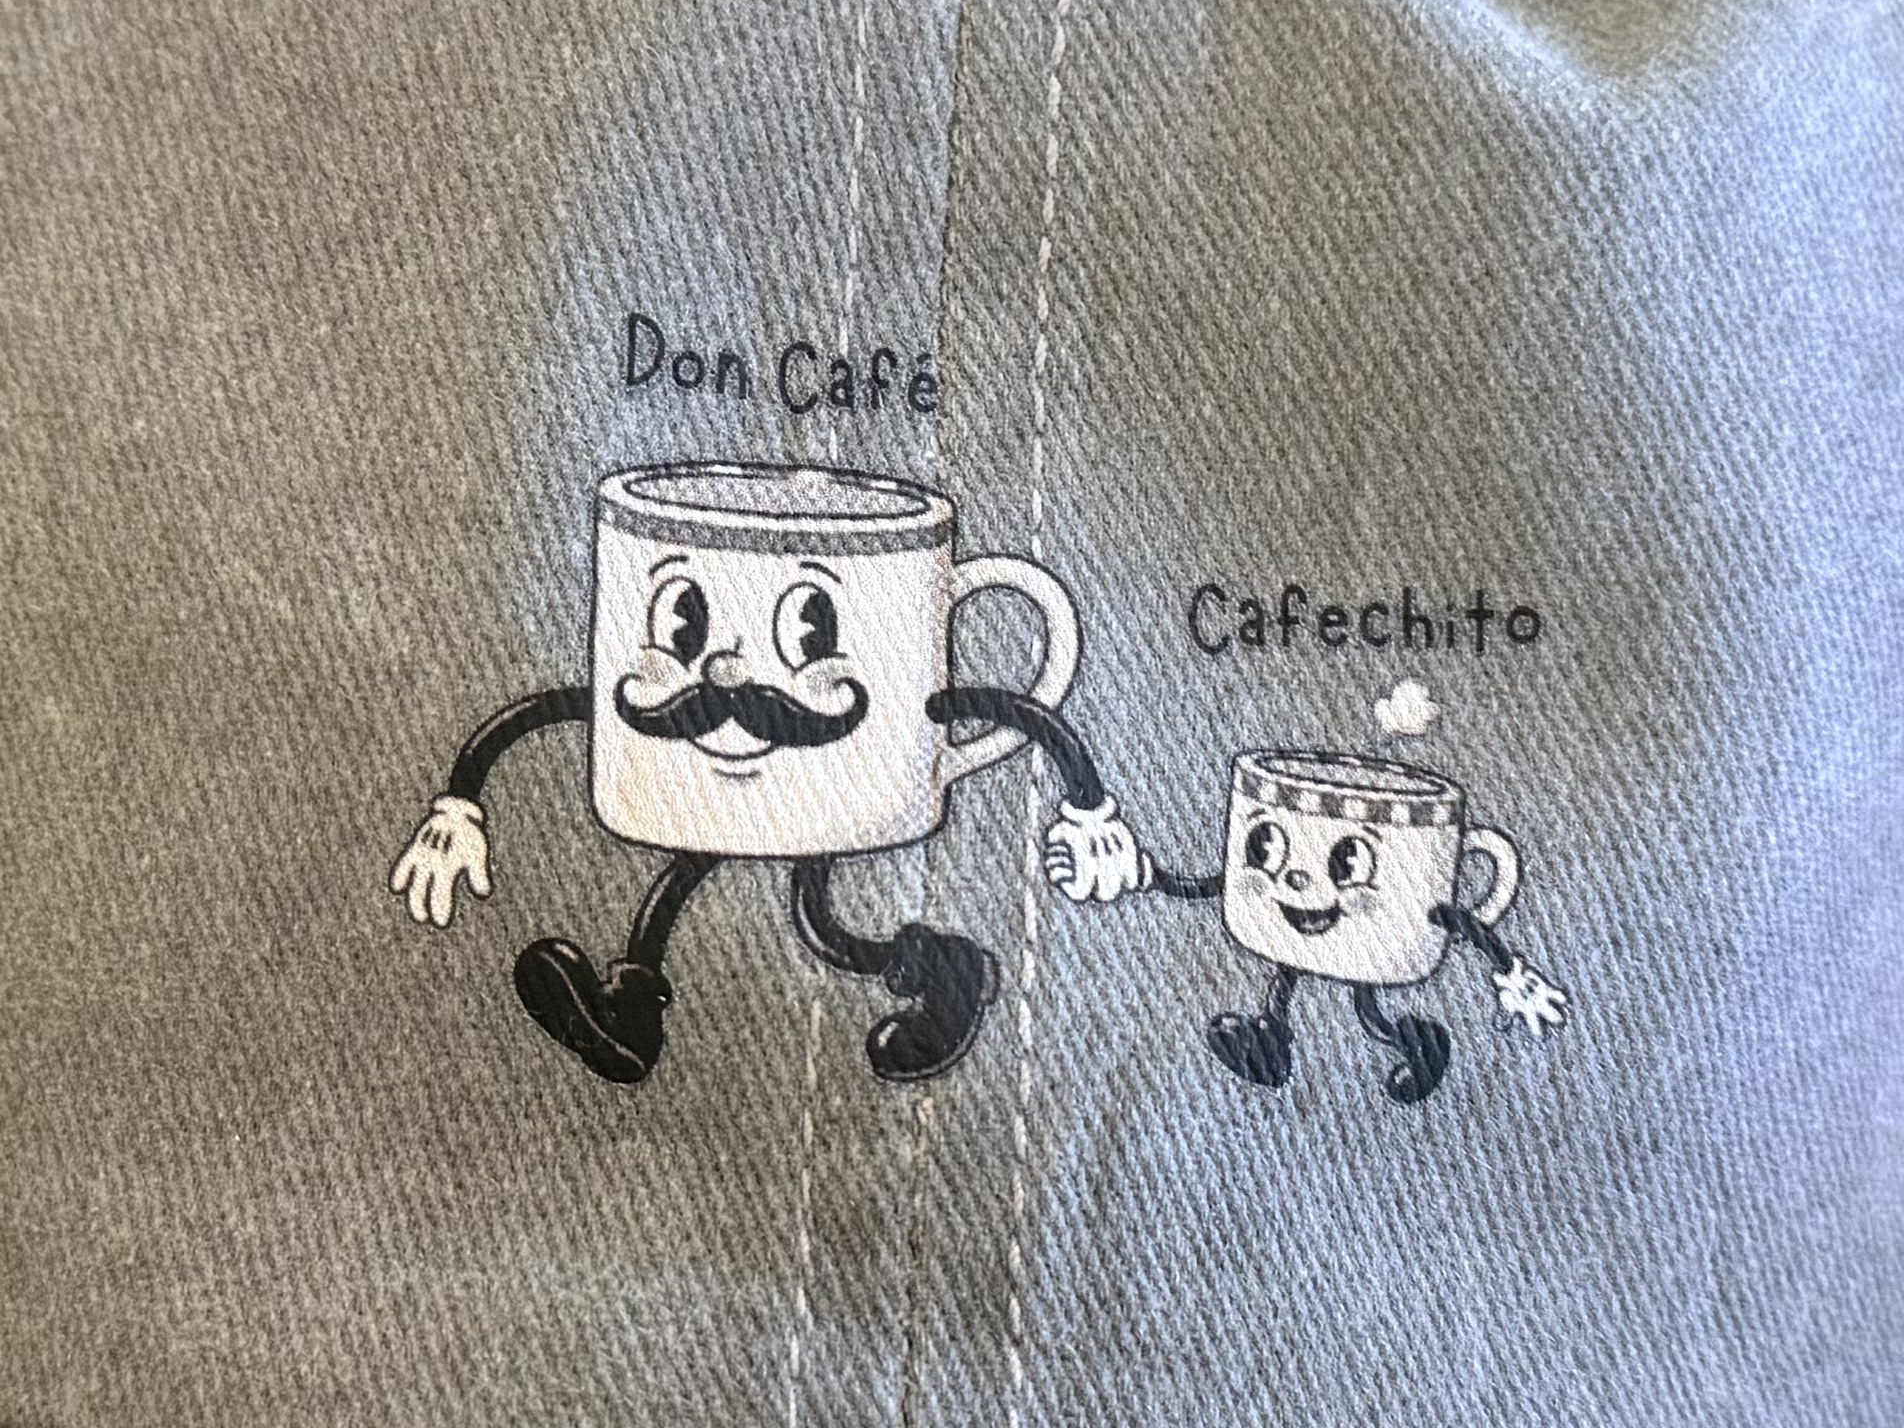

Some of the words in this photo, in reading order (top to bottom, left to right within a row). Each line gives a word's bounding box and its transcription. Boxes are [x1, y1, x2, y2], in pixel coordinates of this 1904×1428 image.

[625, 311, 749, 400] Don
[778, 340, 939, 414] Café
[1187, 582, 1541, 656] Cafechito
